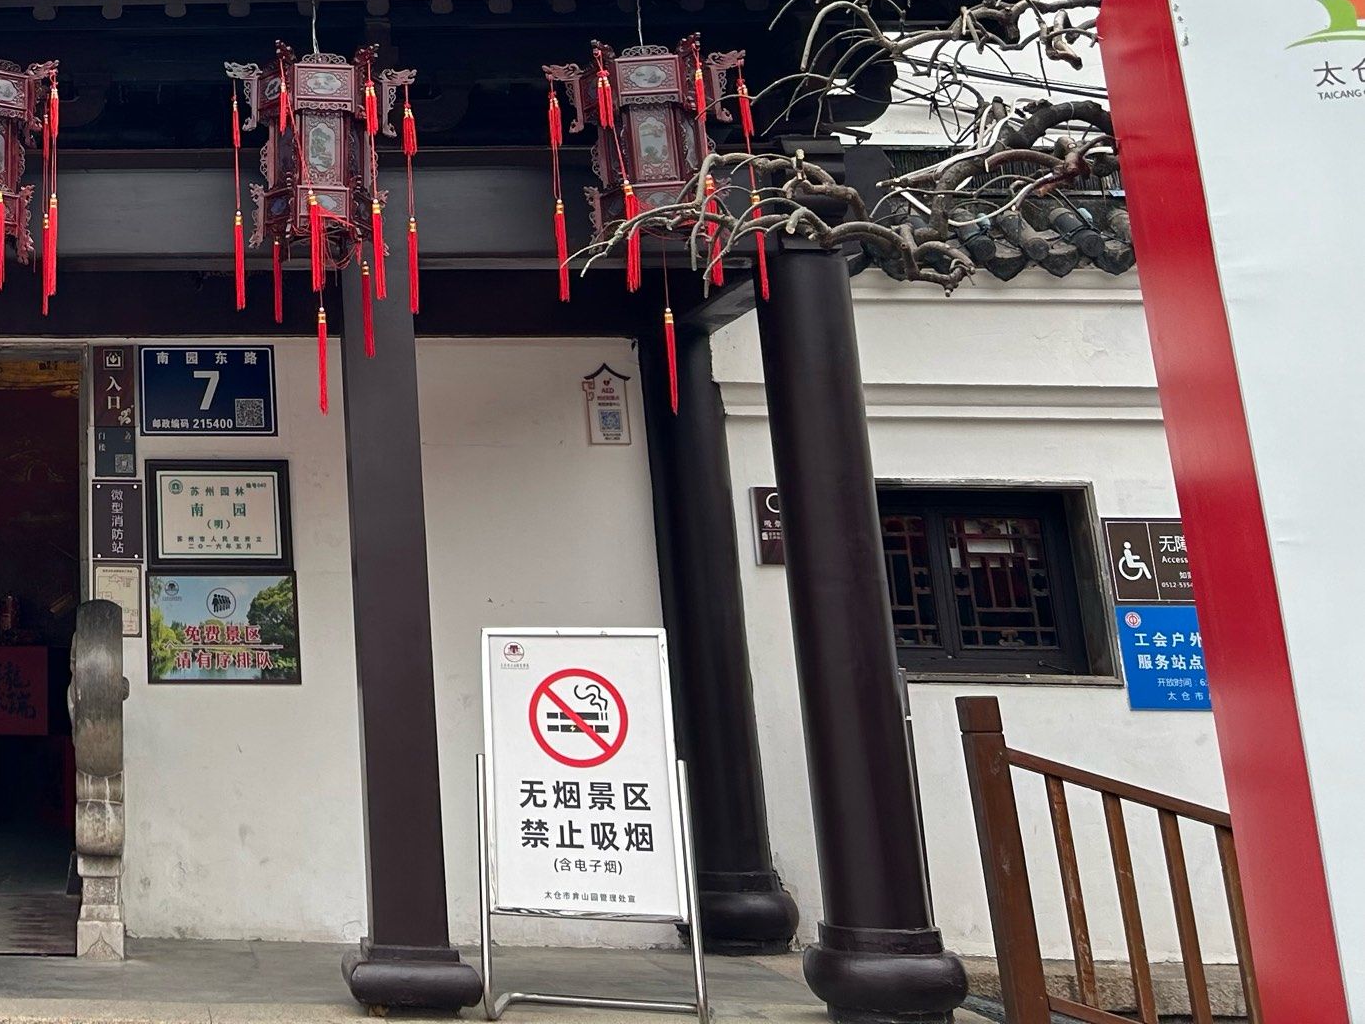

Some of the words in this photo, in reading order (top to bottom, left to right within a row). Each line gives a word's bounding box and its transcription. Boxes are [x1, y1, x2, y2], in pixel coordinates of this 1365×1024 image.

[1317, 89, 1362, 101] TAICANG
[156, 351, 257, 365] 南园东路
[106, 376, 123, 410] 入口
[193, 370, 220, 411] 7
[152, 418, 190, 429] 邮政编码
[192, 418, 234, 429] 215400
[190, 486, 245, 496] 苏州园林
[191, 502, 246, 517] 南园
[111, 489, 124, 554] 微型消防站
[184, 624, 262, 643] 免费景区
[1134, 632, 1202, 648] 工会户外
[176, 650, 274, 670] 请有序排队
[1137, 654, 1204, 670] 服务站点
[1167, 691, 1212, 701] 太仓市
[519, 780, 652, 811] 无烟景区
[520, 818, 654, 852] 禁止吸烟
